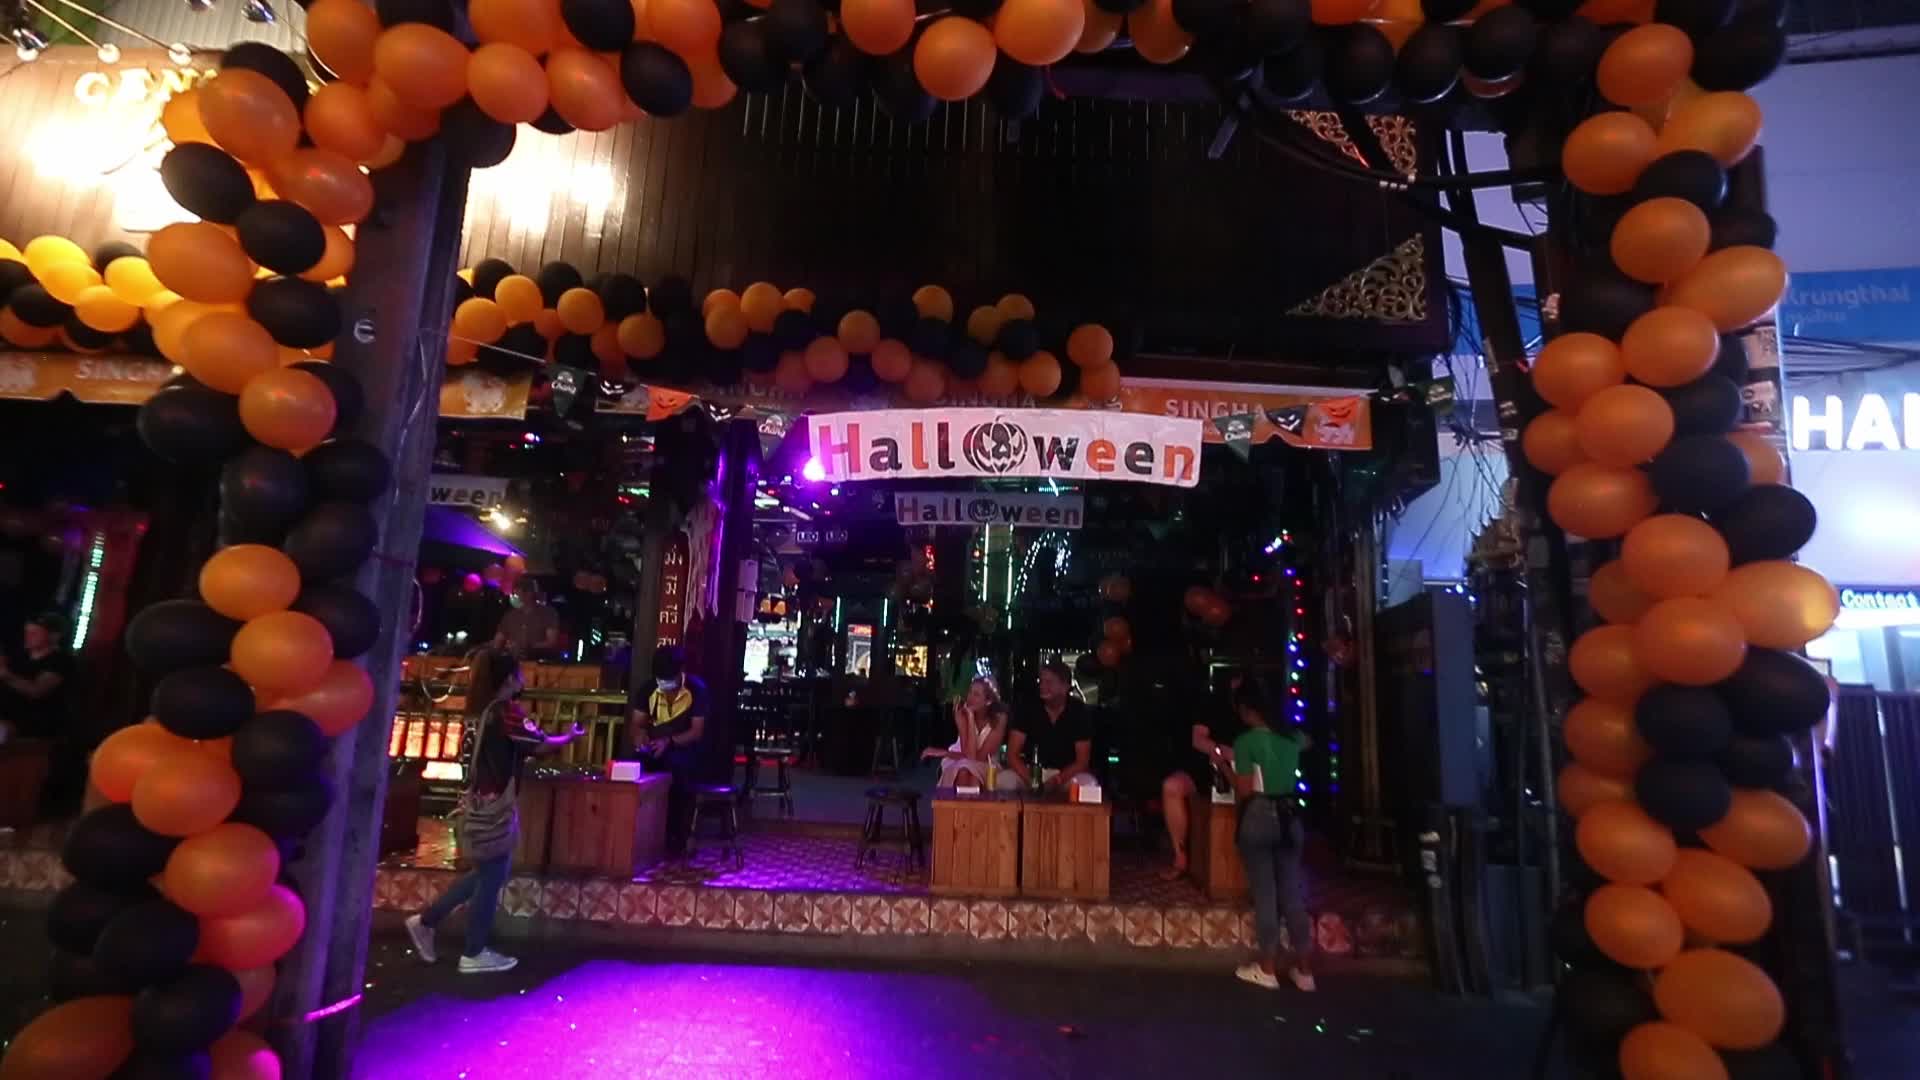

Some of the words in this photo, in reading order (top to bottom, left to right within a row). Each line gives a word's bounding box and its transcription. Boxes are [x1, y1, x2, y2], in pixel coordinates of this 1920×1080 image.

[1165, 399, 1275, 422] SINGHA
[819, 416, 1194, 480] Halloween
[898, 498, 1079, 525] Halloween
